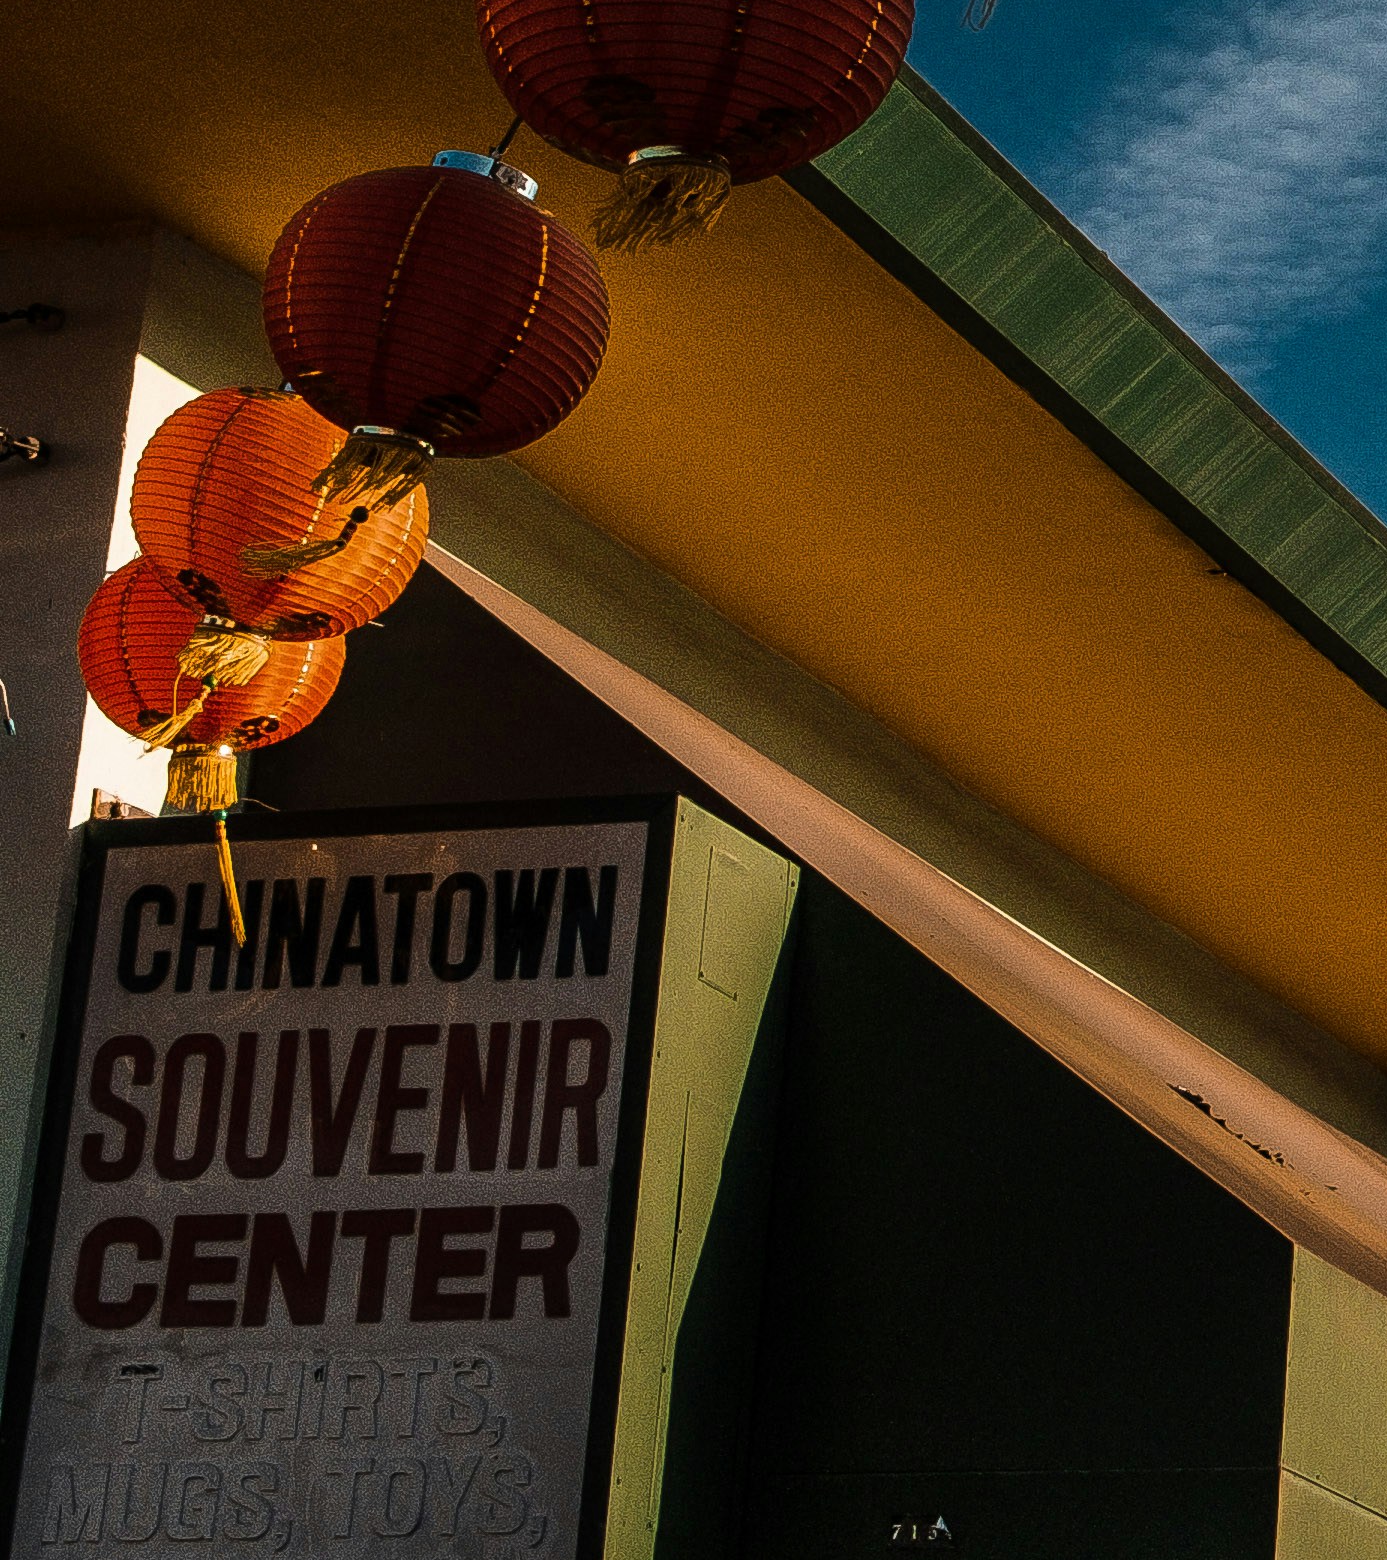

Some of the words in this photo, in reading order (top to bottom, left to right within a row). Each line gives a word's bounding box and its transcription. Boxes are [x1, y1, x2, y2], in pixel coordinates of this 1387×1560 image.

[115, 865, 618, 994] CHINATOWN
[80, 1017, 613, 1183] SOUVENIR
[71, 1201, 581, 1330] CENTER
